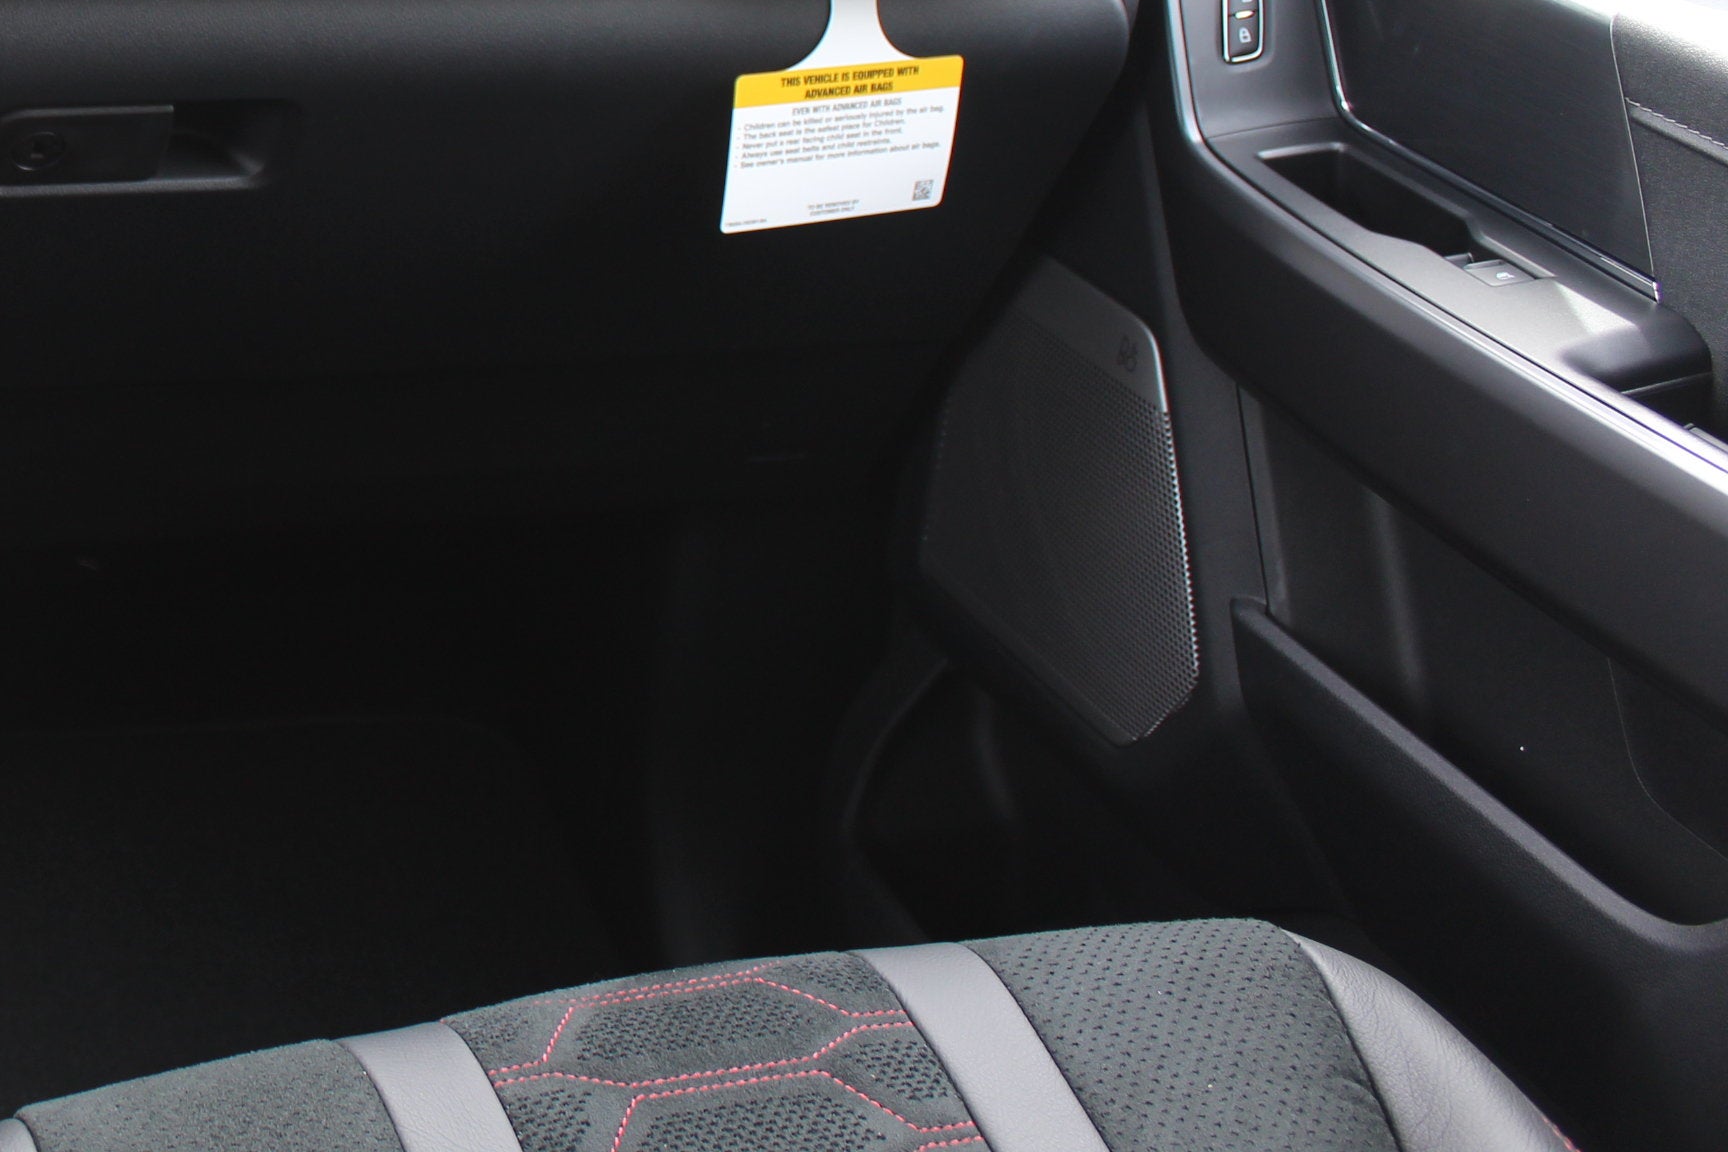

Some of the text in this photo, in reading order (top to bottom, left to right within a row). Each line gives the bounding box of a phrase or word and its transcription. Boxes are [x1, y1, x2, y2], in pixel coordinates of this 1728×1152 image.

[781, 65, 919, 88] THIS VEHICLE IS EQUIPPED WITH
[805, 81, 893, 99] ADVANCED AIR BAGS
[791, 97, 902, 116] EVEN WITH ADVANCED AIR BAGS
